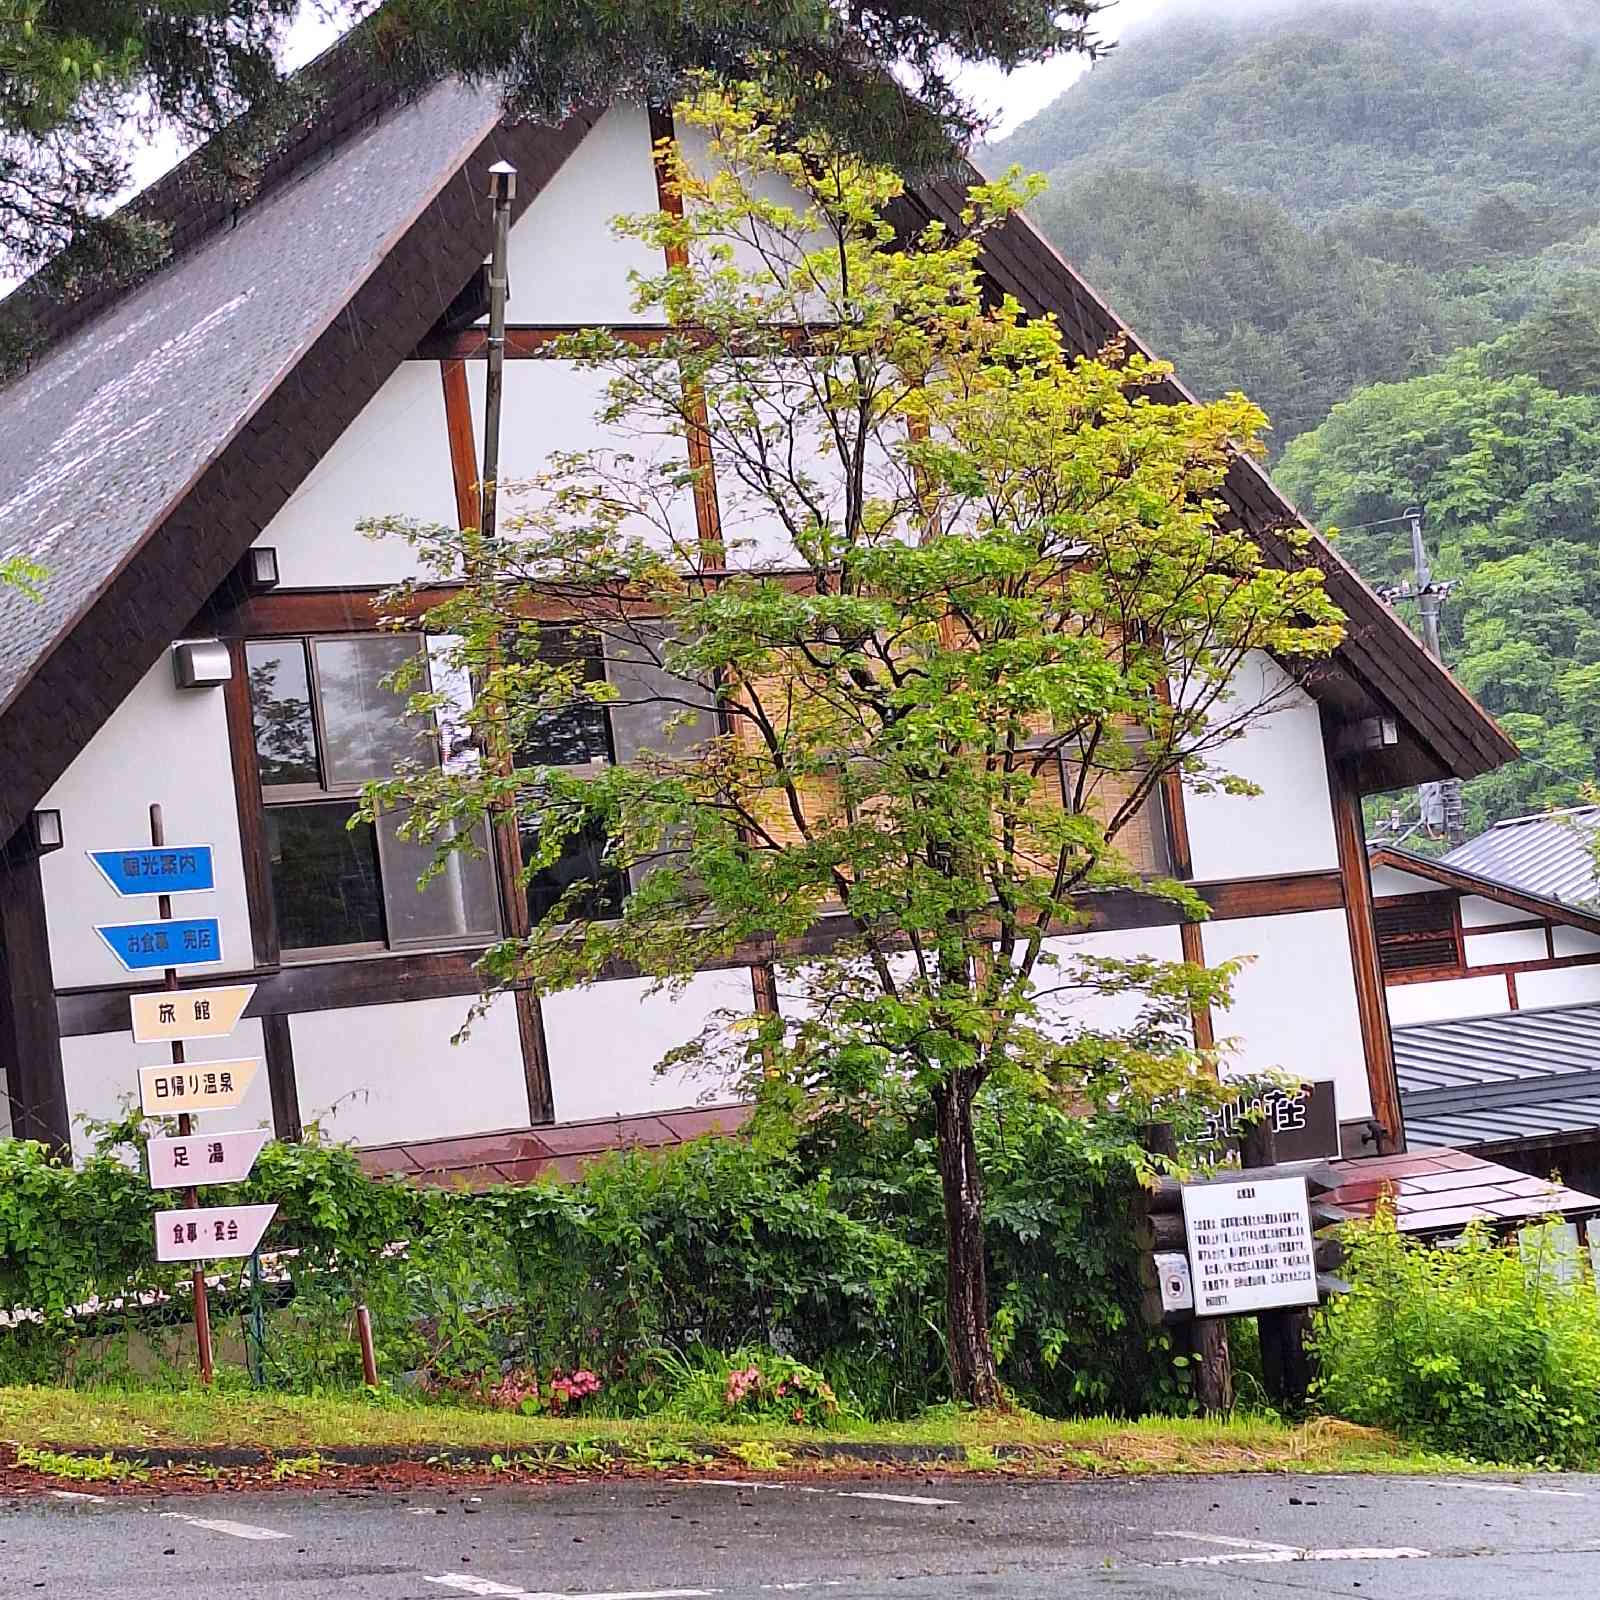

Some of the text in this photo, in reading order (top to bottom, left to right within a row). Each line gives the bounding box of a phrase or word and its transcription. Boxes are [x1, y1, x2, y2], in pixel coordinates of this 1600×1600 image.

[127, 930, 169, 953] お食事
[154, 1072, 234, 1098] 日帰り温泉
[173, 1142, 225, 1168] 足湯
